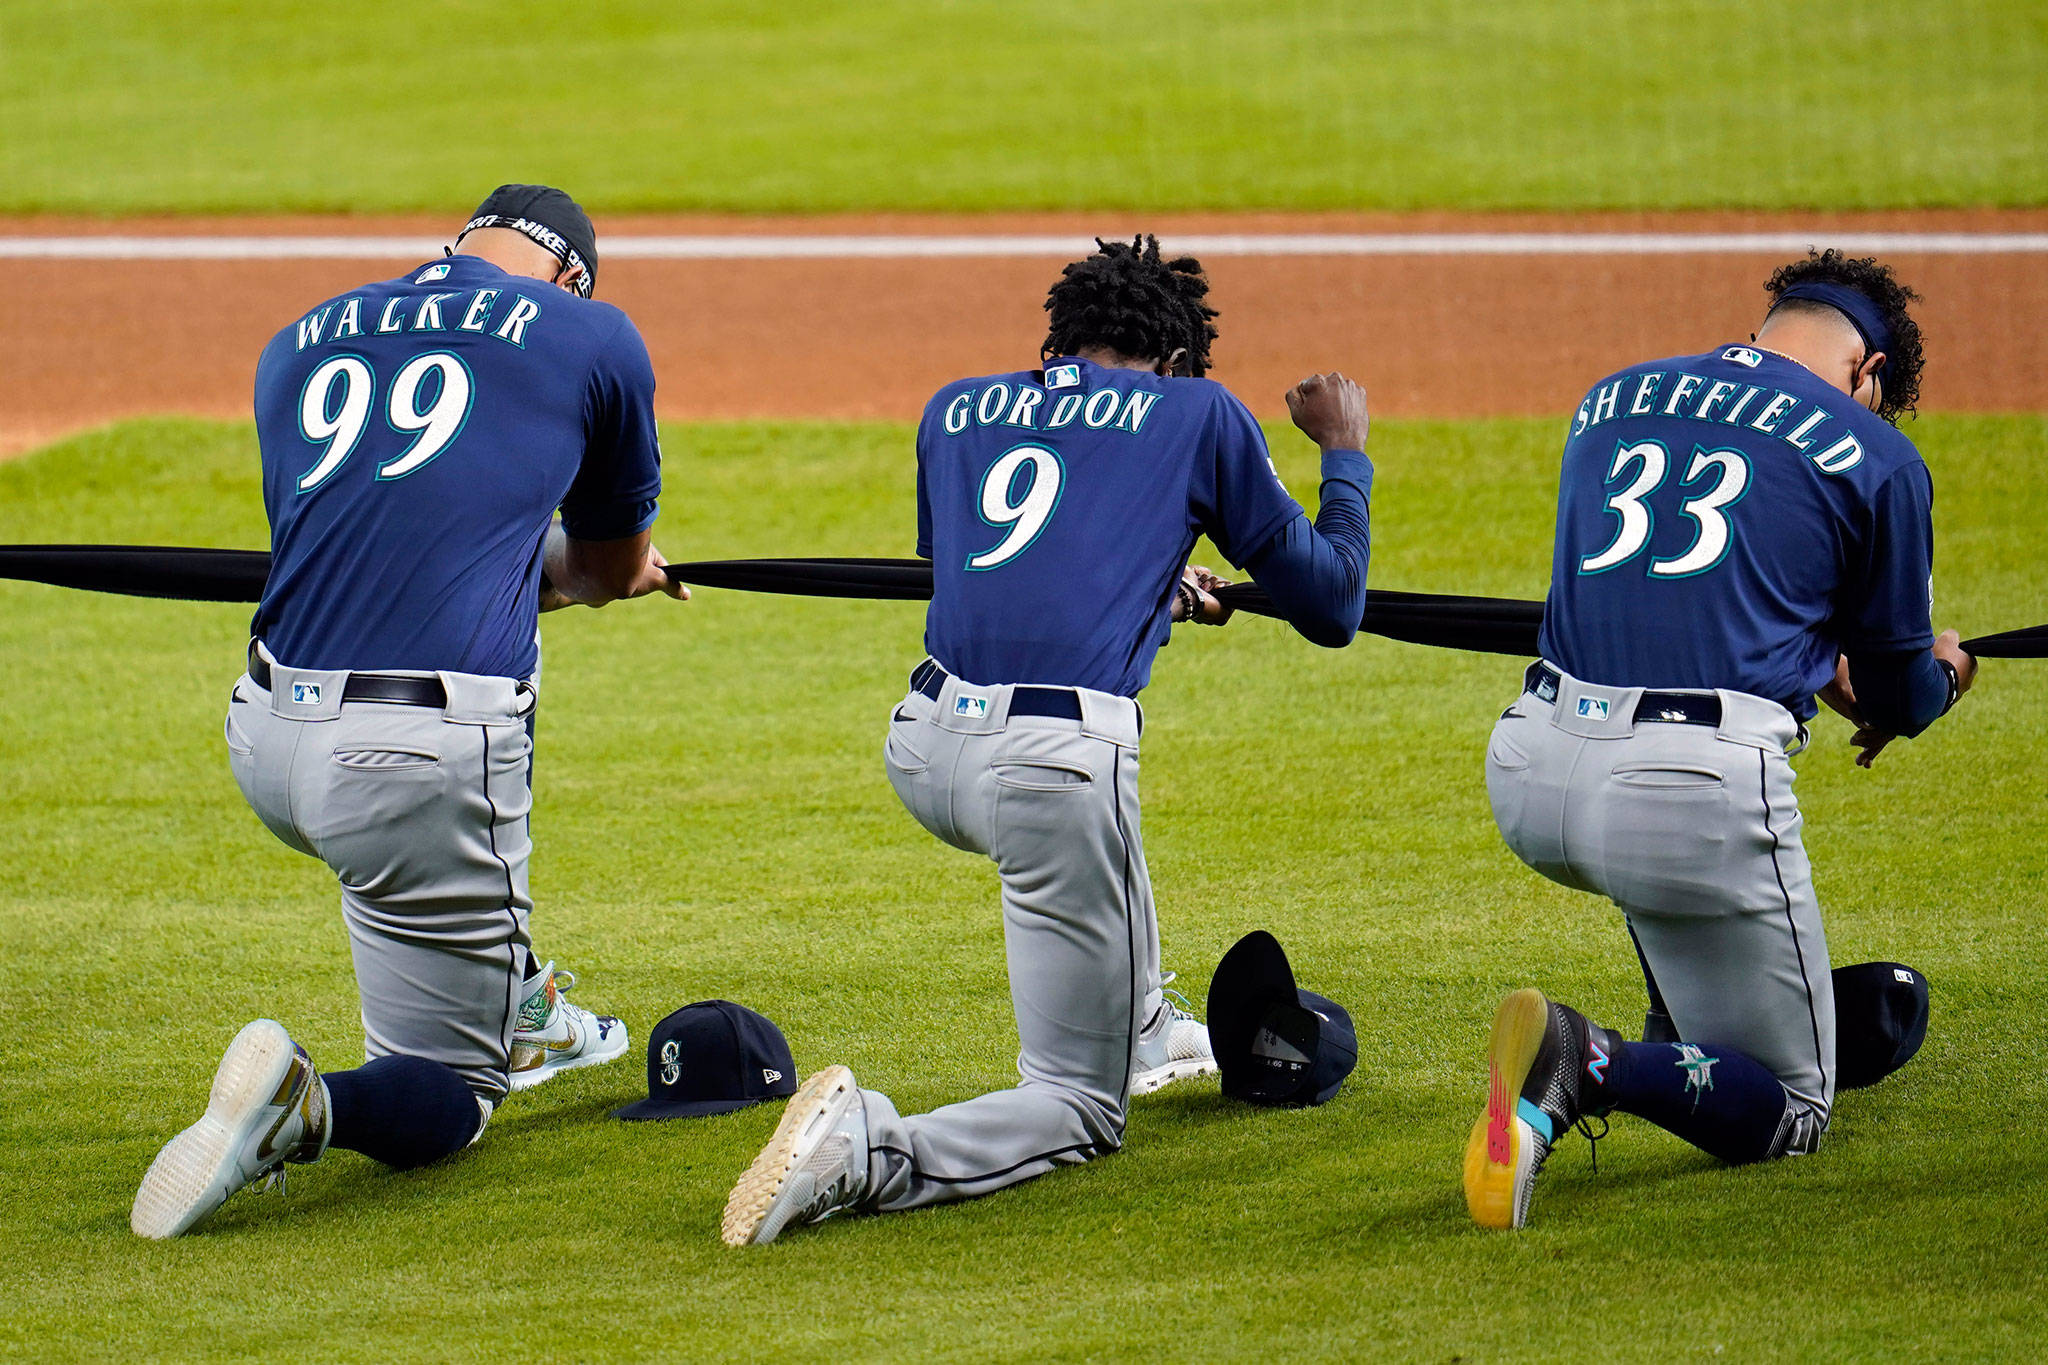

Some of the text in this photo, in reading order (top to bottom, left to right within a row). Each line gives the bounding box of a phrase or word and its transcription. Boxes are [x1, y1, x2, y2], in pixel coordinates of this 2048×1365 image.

[512, 218, 568, 254] NIKE
[296, 289, 542, 353] WALKER
[296, 350, 476, 495] 99
[943, 382, 1164, 435] GORDON
[1574, 371, 1865, 475] SHEFFIELD
[964, 442, 1066, 572] 9
[1577, 438, 1753, 580] 33
